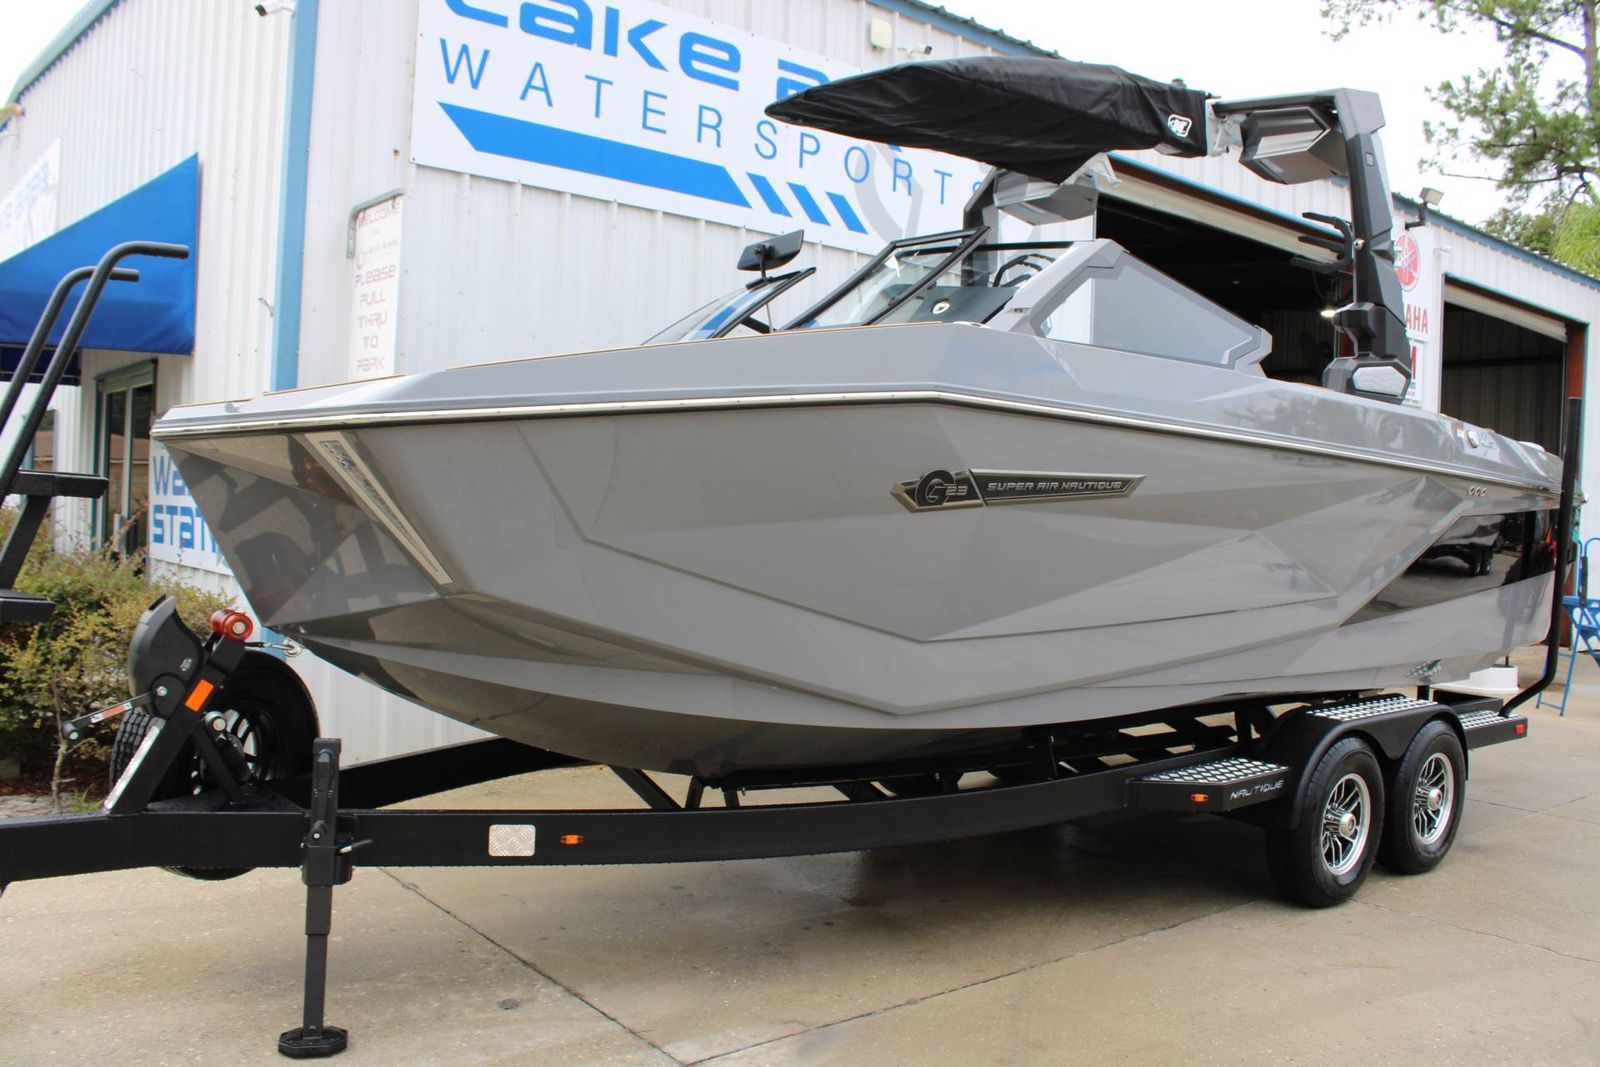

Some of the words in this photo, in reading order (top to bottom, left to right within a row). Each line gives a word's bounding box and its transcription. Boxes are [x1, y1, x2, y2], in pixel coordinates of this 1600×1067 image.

[440, 37, 984, 206] WATERSPORT
[360, 289, 386, 307] PULL
[358, 311, 388, 330] THRU
[1406, 303, 1429, 334] AHA
[362, 335, 379, 350] TO
[987, 482, 1034, 491] SUPER
[1037, 482, 1059, 491] AIR
[1061, 481, 1122, 490] NAUTIQUE
[1230, 780, 1285, 800] NAUTIQUE
